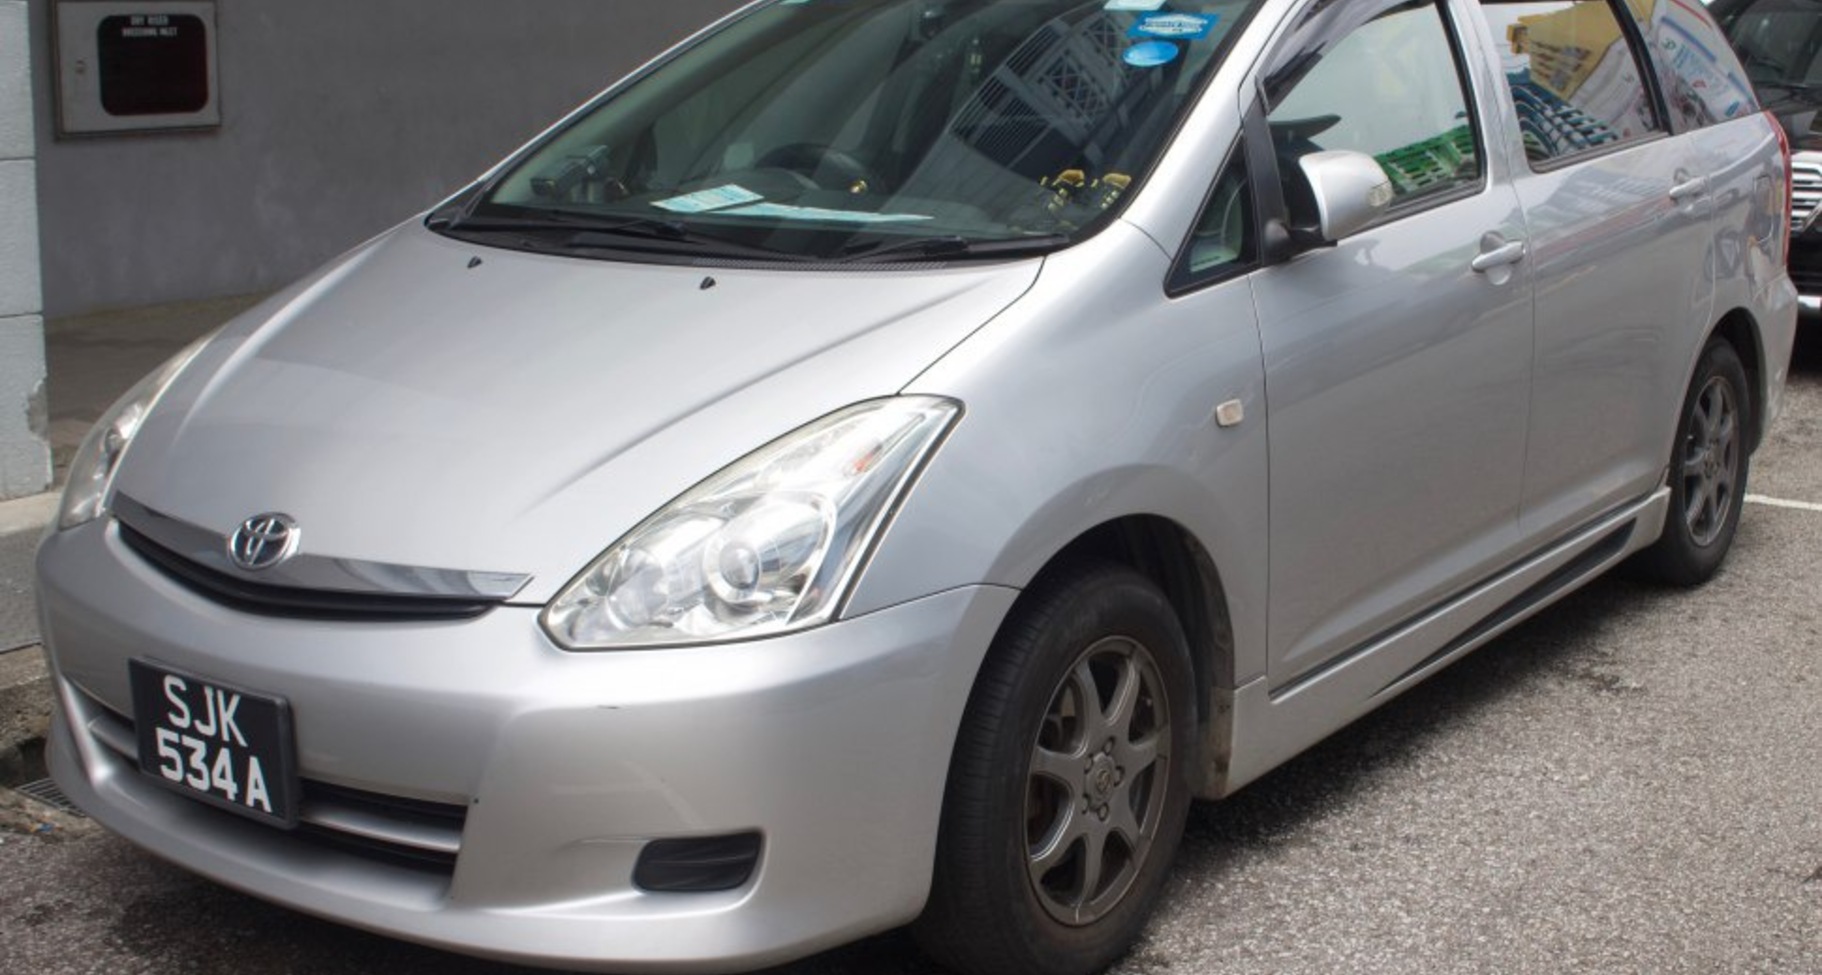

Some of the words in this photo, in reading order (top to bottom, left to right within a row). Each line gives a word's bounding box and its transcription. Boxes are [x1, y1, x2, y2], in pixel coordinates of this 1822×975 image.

[163, 675, 248, 748] SJK
[156, 727, 239, 802] 534
[246, 756, 273, 813] A
